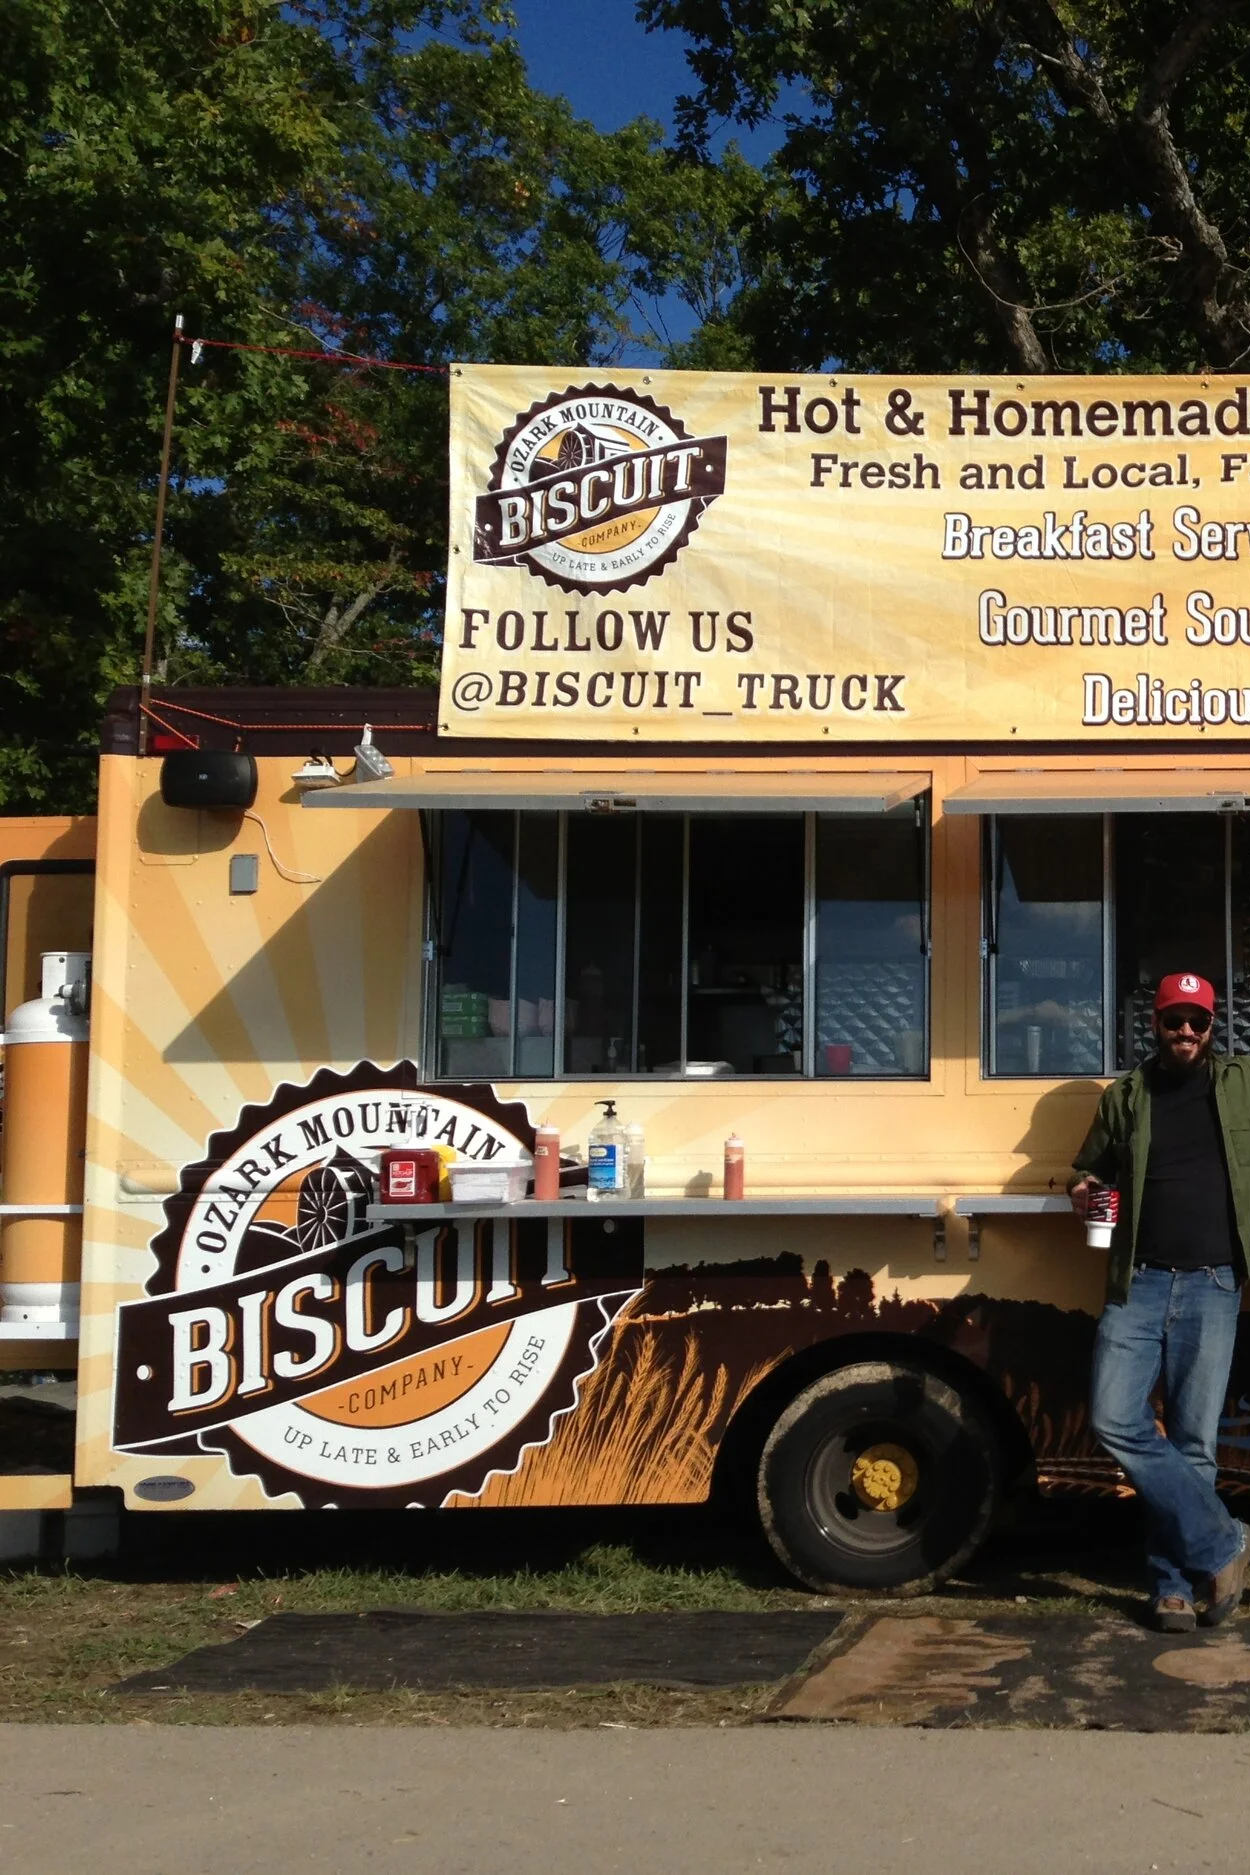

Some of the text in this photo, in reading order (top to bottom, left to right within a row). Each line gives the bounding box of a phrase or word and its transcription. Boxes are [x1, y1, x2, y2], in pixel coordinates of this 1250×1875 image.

[512, 402, 660, 474] OZARK MOUNTAIN
[758, 386, 861, 435] Hot
[884, 388, 925, 437] &
[498, 446, 703, 548] BISCUIT
[810, 453, 941, 490] Fresh
[959, 454, 1046, 490] and
[1063, 453, 1201, 490] Local,
[551, 512, 676, 572] UP LATE & EARLY TO RISE
[942, 511, 1155, 561] Breakfast
[459, 609, 754, 653] FOLLOW US
[978, 589, 1168, 646] Gourmet
[452, 671, 906, 716] @BISCUIT_TRUCK
[196, 1101, 507, 1254] OZARK MOUNTAIN
[283, 1334, 546, 1465] UP LATE & EARLY TO RISE
